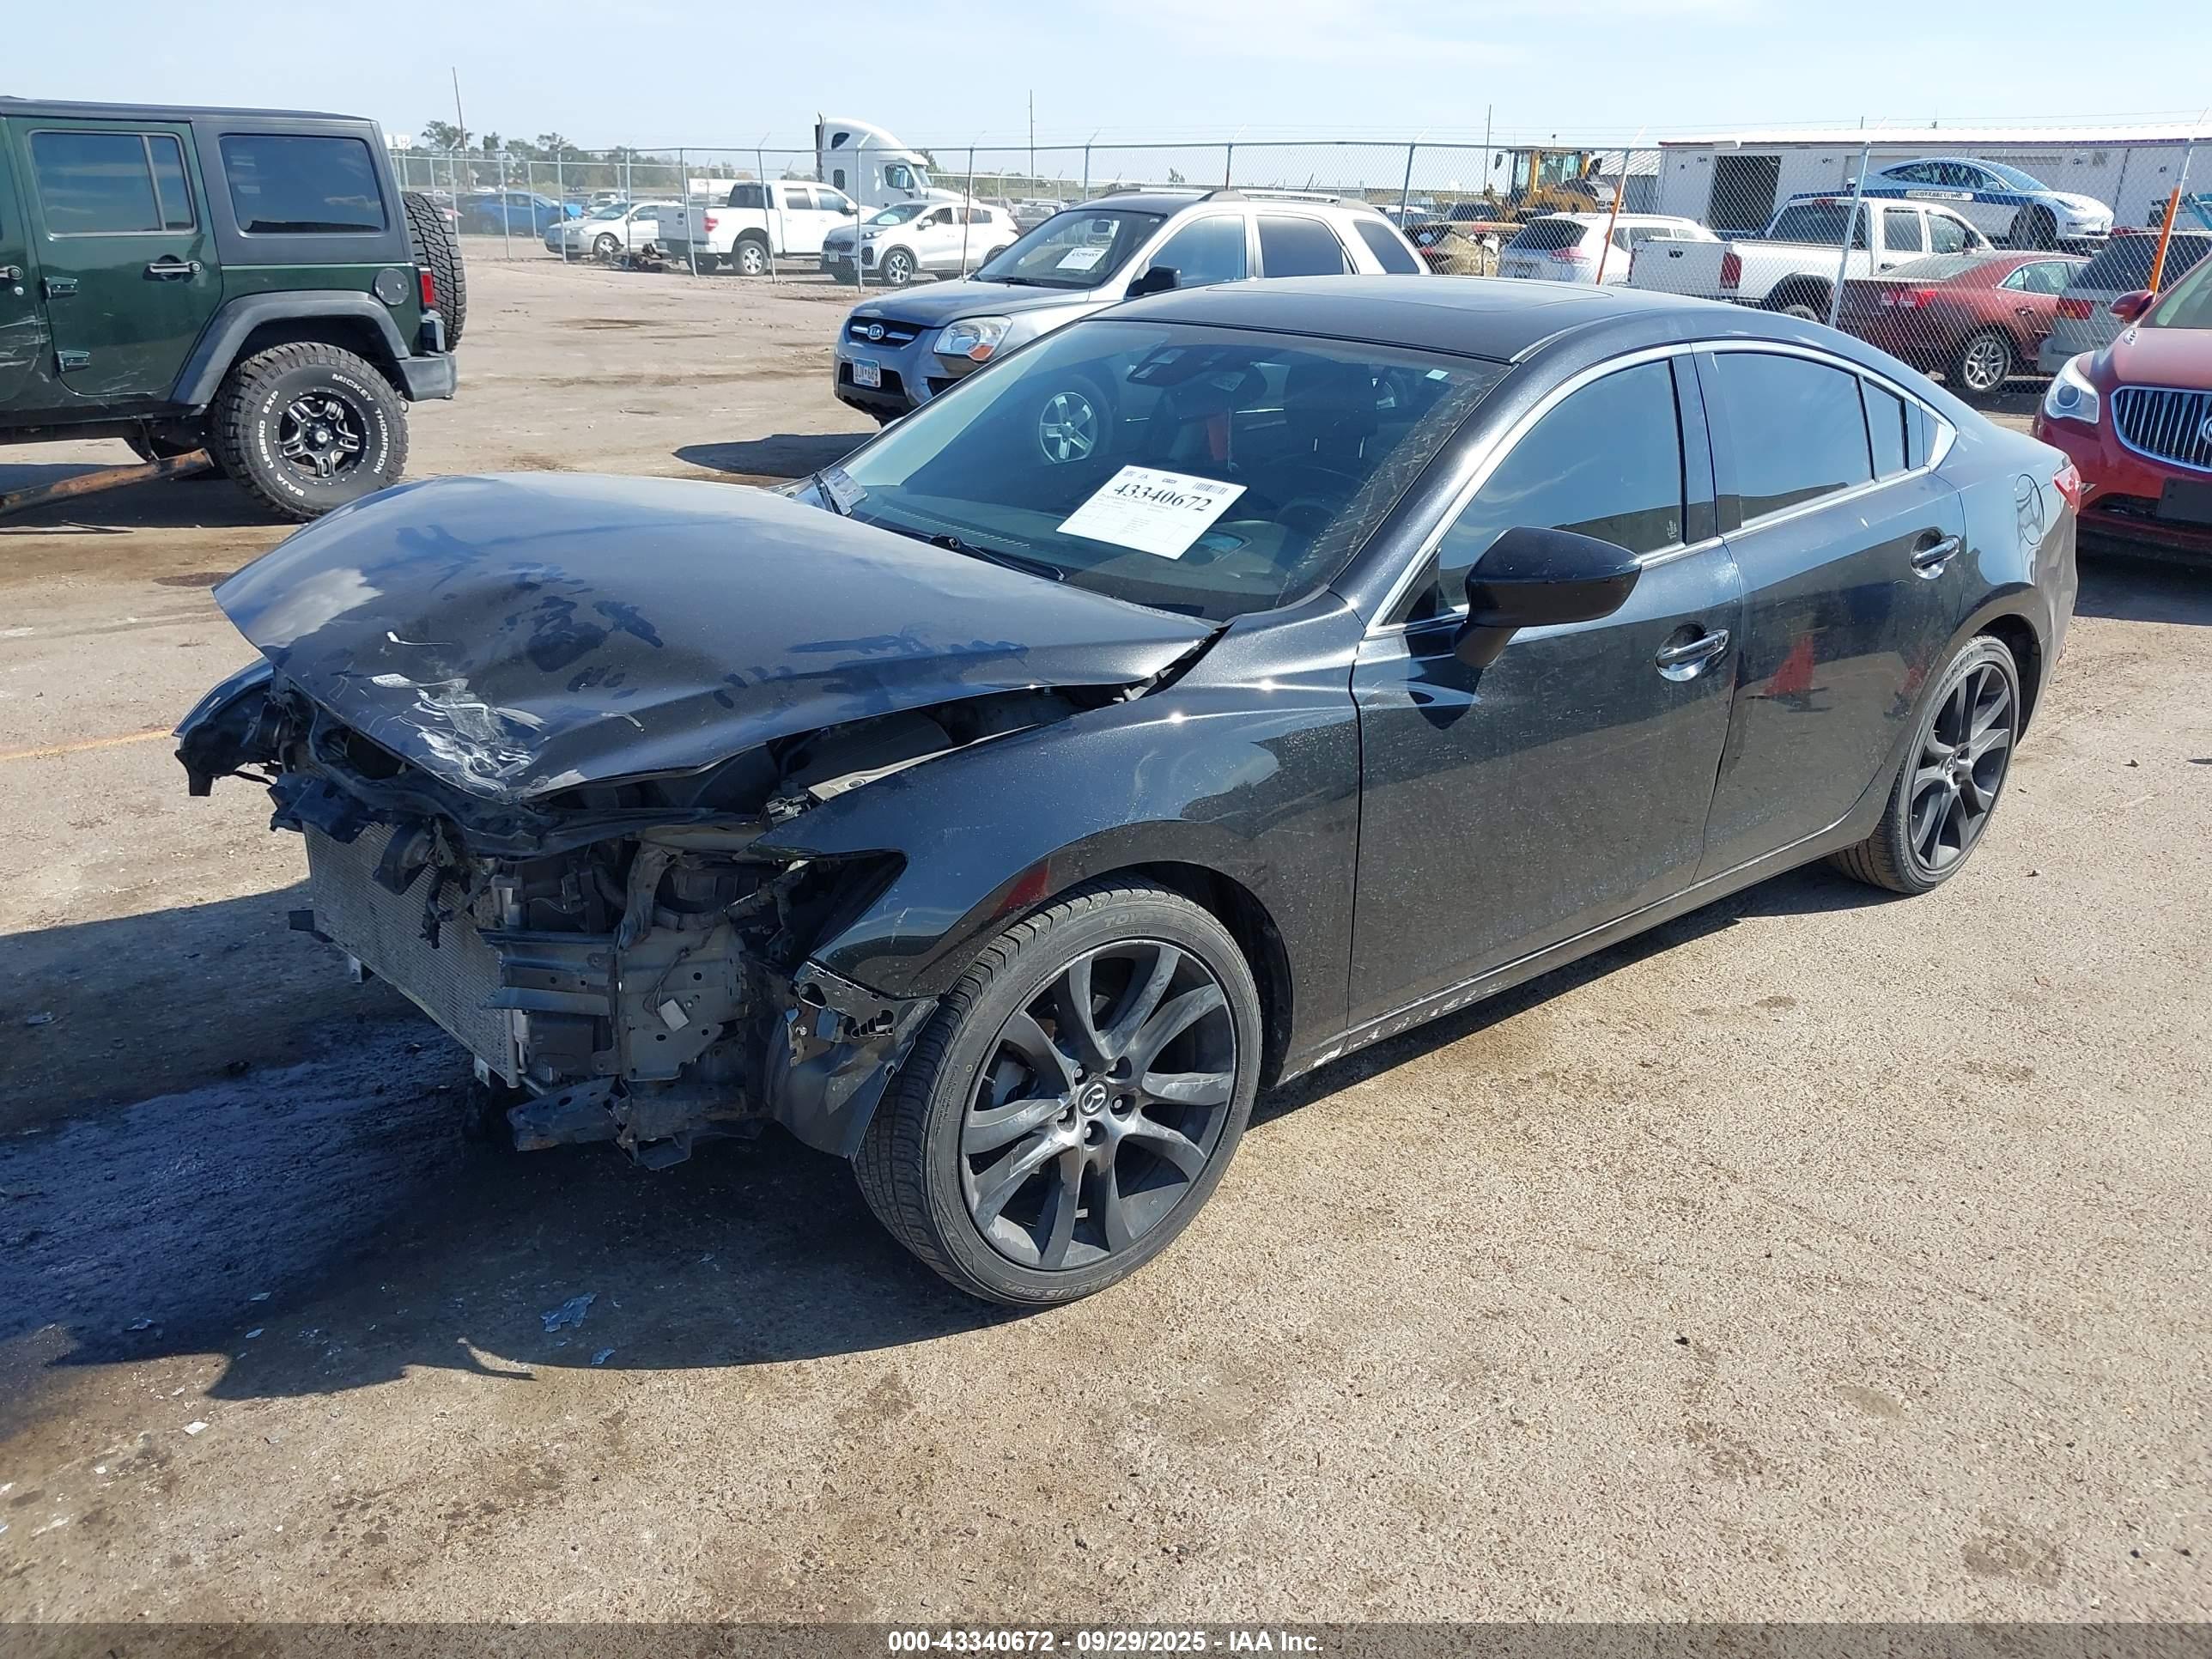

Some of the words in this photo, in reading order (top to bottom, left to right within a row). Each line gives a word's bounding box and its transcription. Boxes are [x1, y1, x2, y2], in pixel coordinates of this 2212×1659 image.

[869, 326, 881, 337] KIA
[262, 390, 280, 414] EXP
[331, 373, 374, 403] MICKEY
[373, 407, 389, 474] THOMPSON
[258, 419, 275, 470] LEGEND
[276, 472, 306, 497] BAJA
[1115, 483, 1212, 512] 43340672
